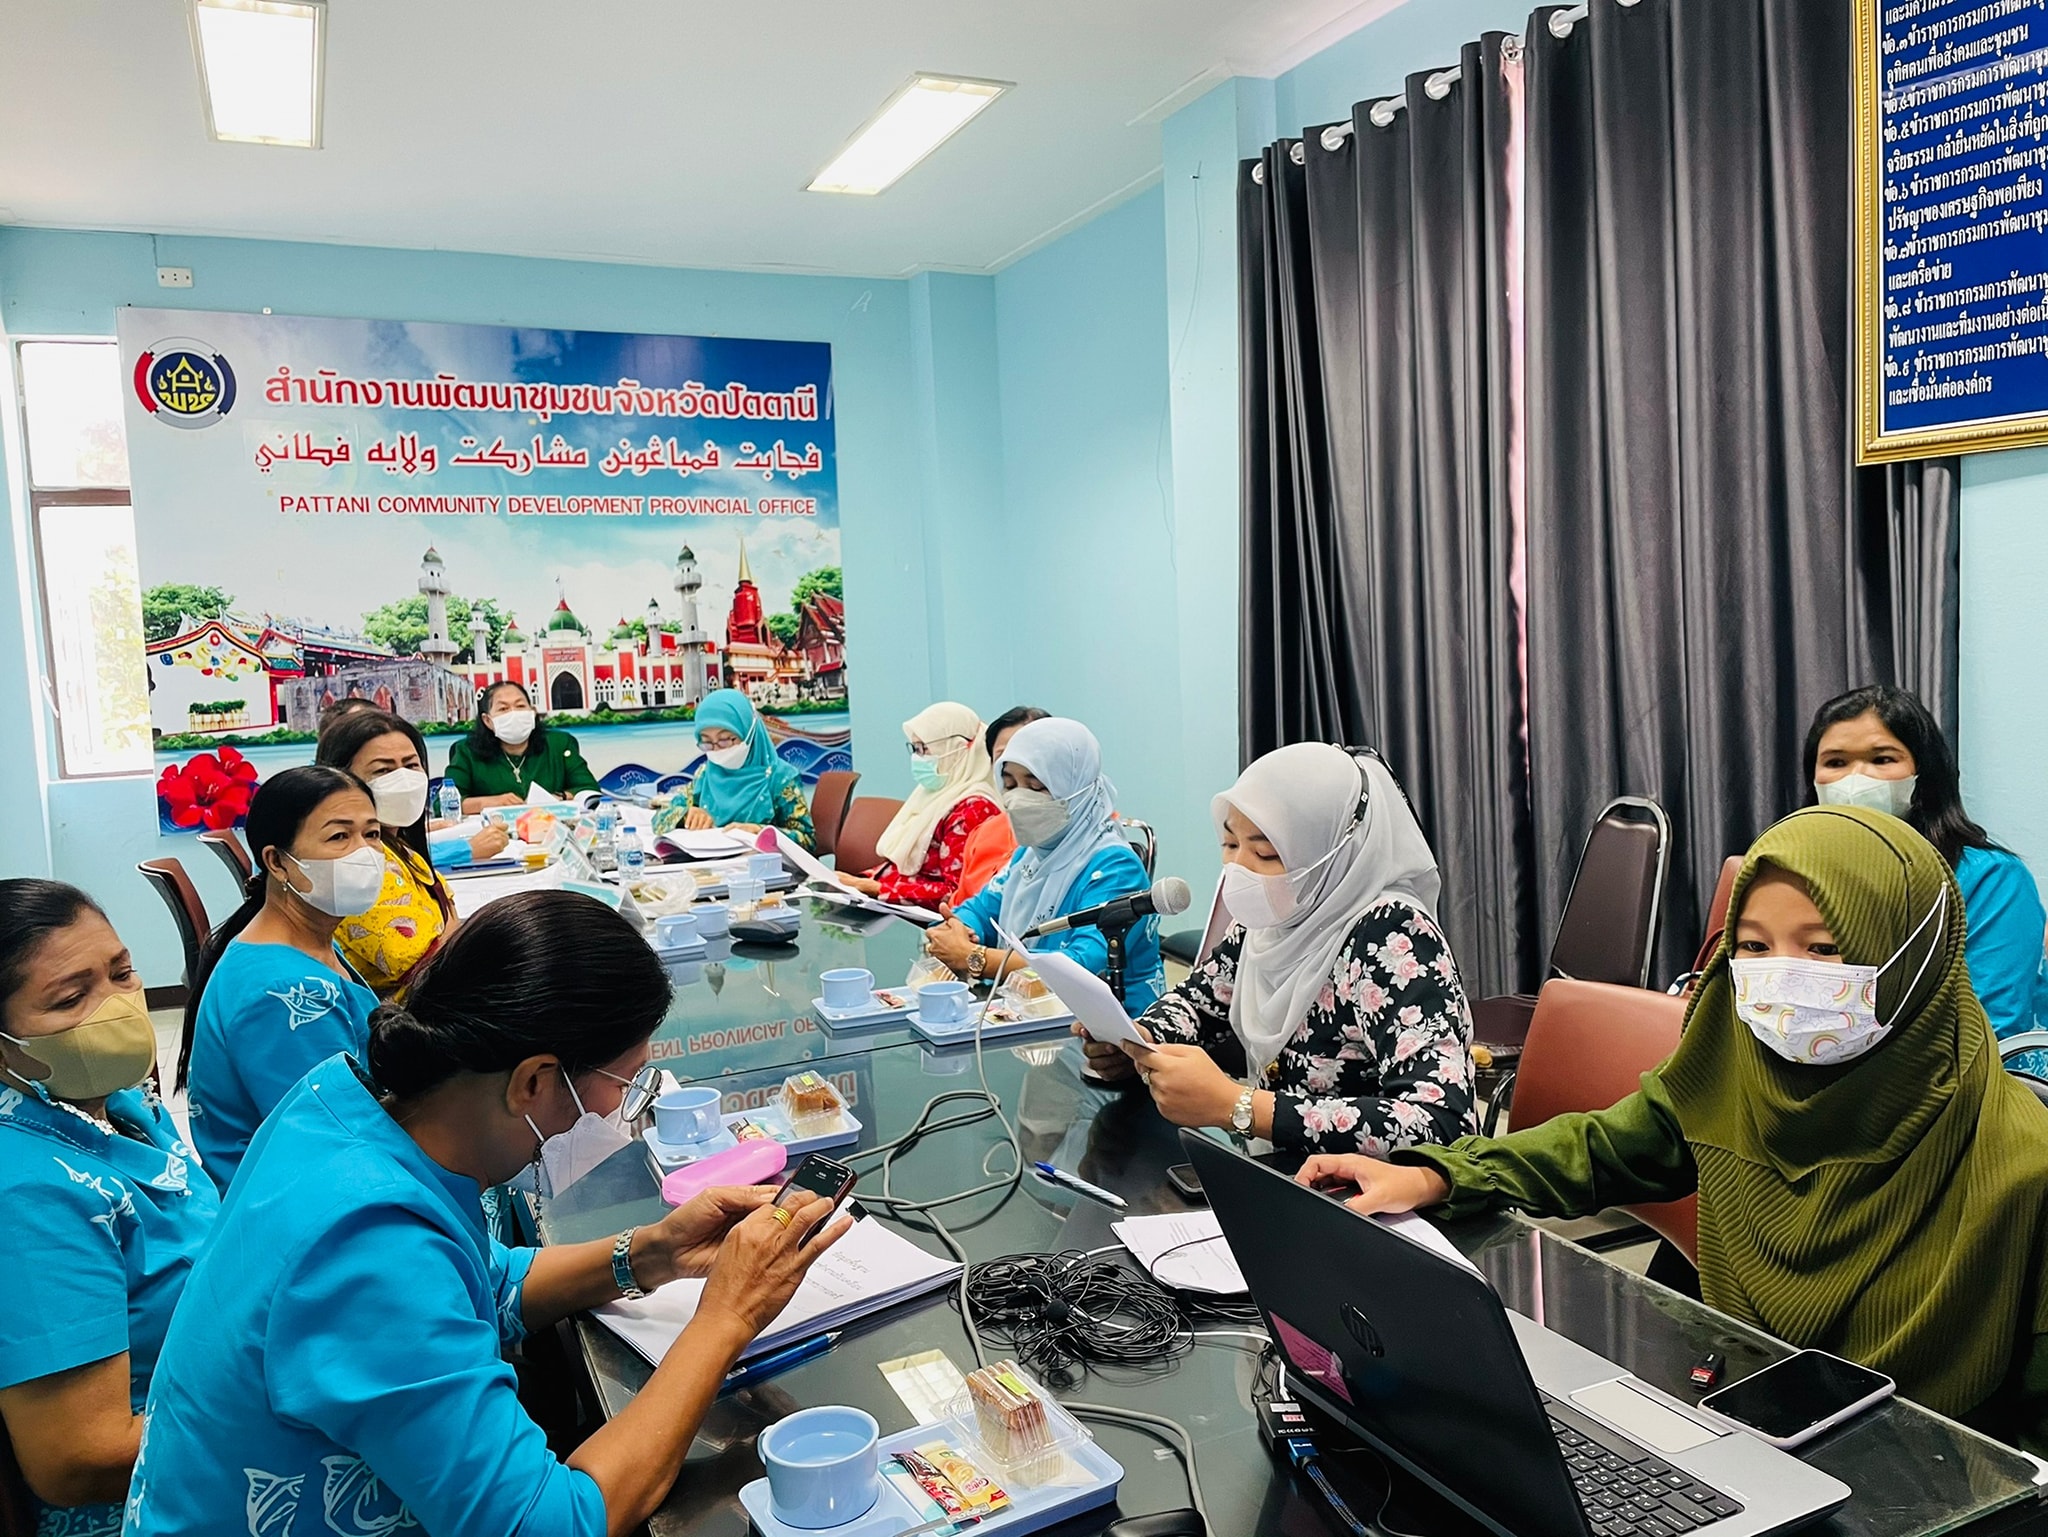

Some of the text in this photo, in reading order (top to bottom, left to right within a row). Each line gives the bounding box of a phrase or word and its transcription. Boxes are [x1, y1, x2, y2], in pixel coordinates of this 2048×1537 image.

[1886, 148, 1934, 174] จริยธรรม
[1887, 173, 2043, 232] ปรัชญาของเศรษฐกิจพอเพียง
[1888, 258, 1952, 291] และเครือข่าย
[265, 366, 817, 420] สำนักงานพัฒนาชุมชนจังหวัดปัตตานี
[1888, 370, 1993, 406] และเชื่อมั่นต่อองค์กร
[280, 496, 816, 515] PATTANI COMMUNITY DEVELOPMENT PROVINCIAL OFFICE
